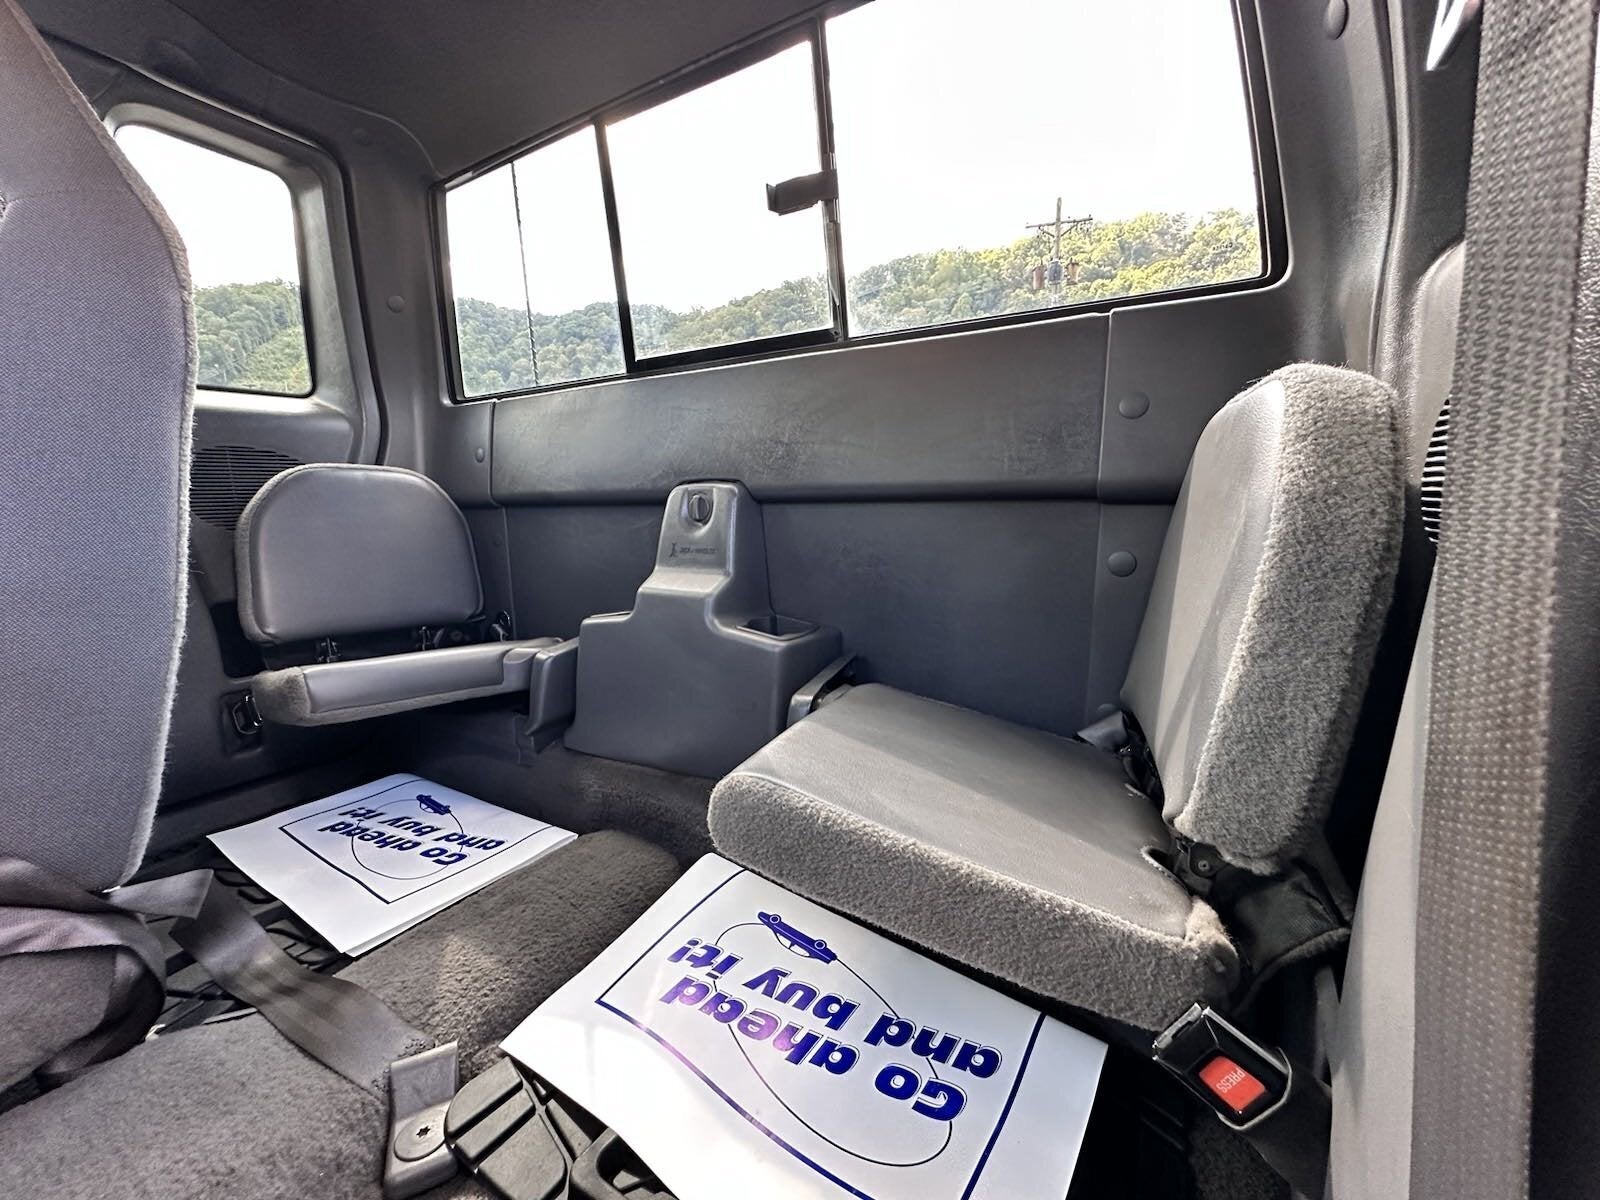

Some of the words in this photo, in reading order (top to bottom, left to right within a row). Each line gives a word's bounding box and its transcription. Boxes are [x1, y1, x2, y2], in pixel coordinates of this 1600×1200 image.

[338, 807, 388, 822] it!
[376, 816, 444, 837] buy
[317, 821, 423, 851] ahead
[433, 832, 507, 851] and
[419, 847, 470, 866] Go
[667, 938, 744, 980] it!
[742, 967, 861, 1030] buy
[659, 975, 860, 1075] ahead
[863, 1011, 1003, 1079] and
[874, 1062, 968, 1121] Go
[1216, 1067, 1246, 1094] PRESS
